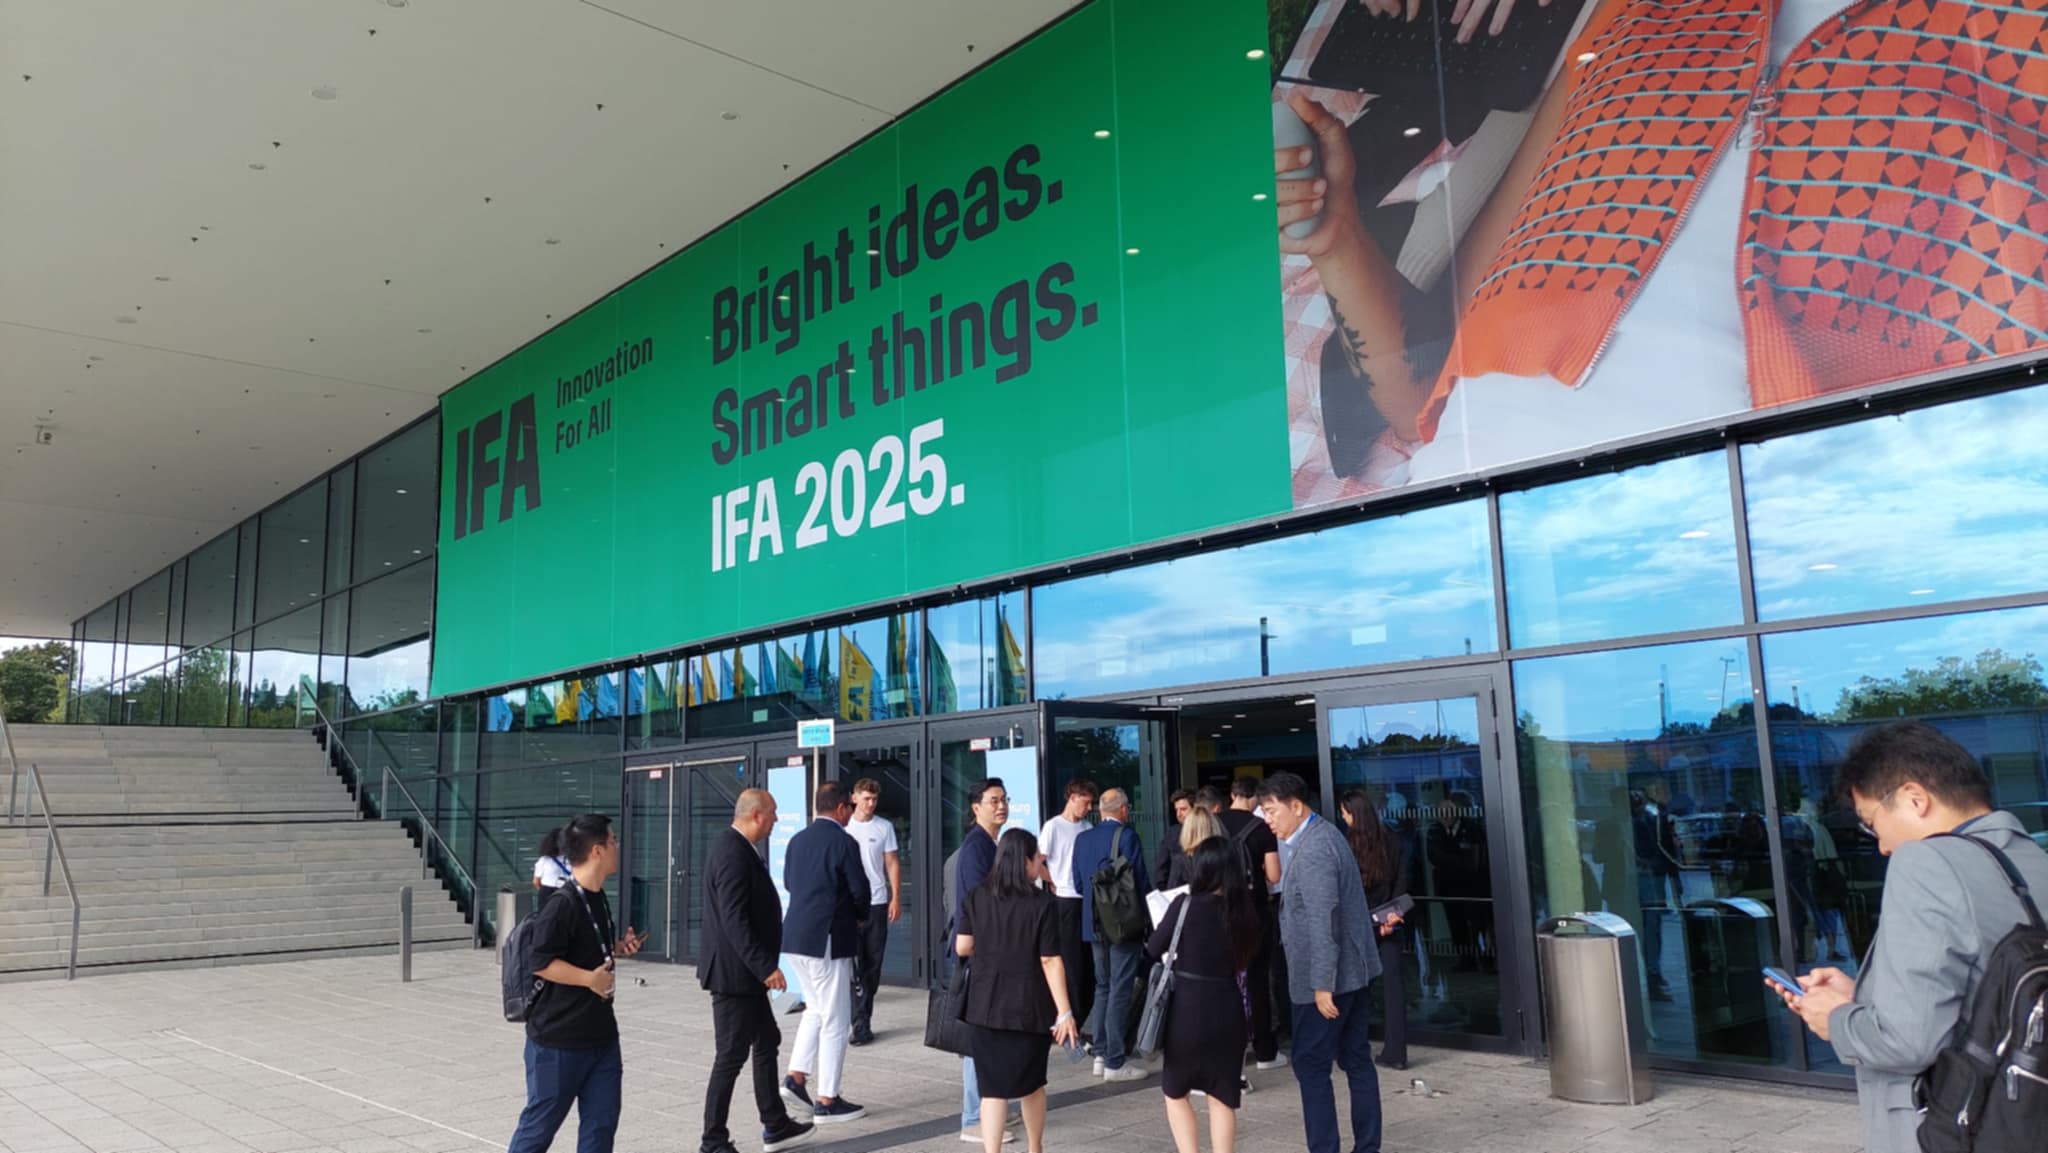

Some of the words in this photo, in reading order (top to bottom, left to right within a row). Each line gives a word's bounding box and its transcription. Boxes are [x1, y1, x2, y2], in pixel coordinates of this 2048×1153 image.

[711, 227, 856, 366] Bright
[868, 143, 1064, 291] ideas.
[555, 420, 583, 454] For
[587, 397, 612, 438] All
[556, 336, 654, 409] Innovation
[711, 341, 856, 466] Smart
[867, 261, 1100, 407] things.
[453, 392, 541, 541] IFA
[711, 477, 784, 573] IFA
[794, 417, 966, 550] 2025.
